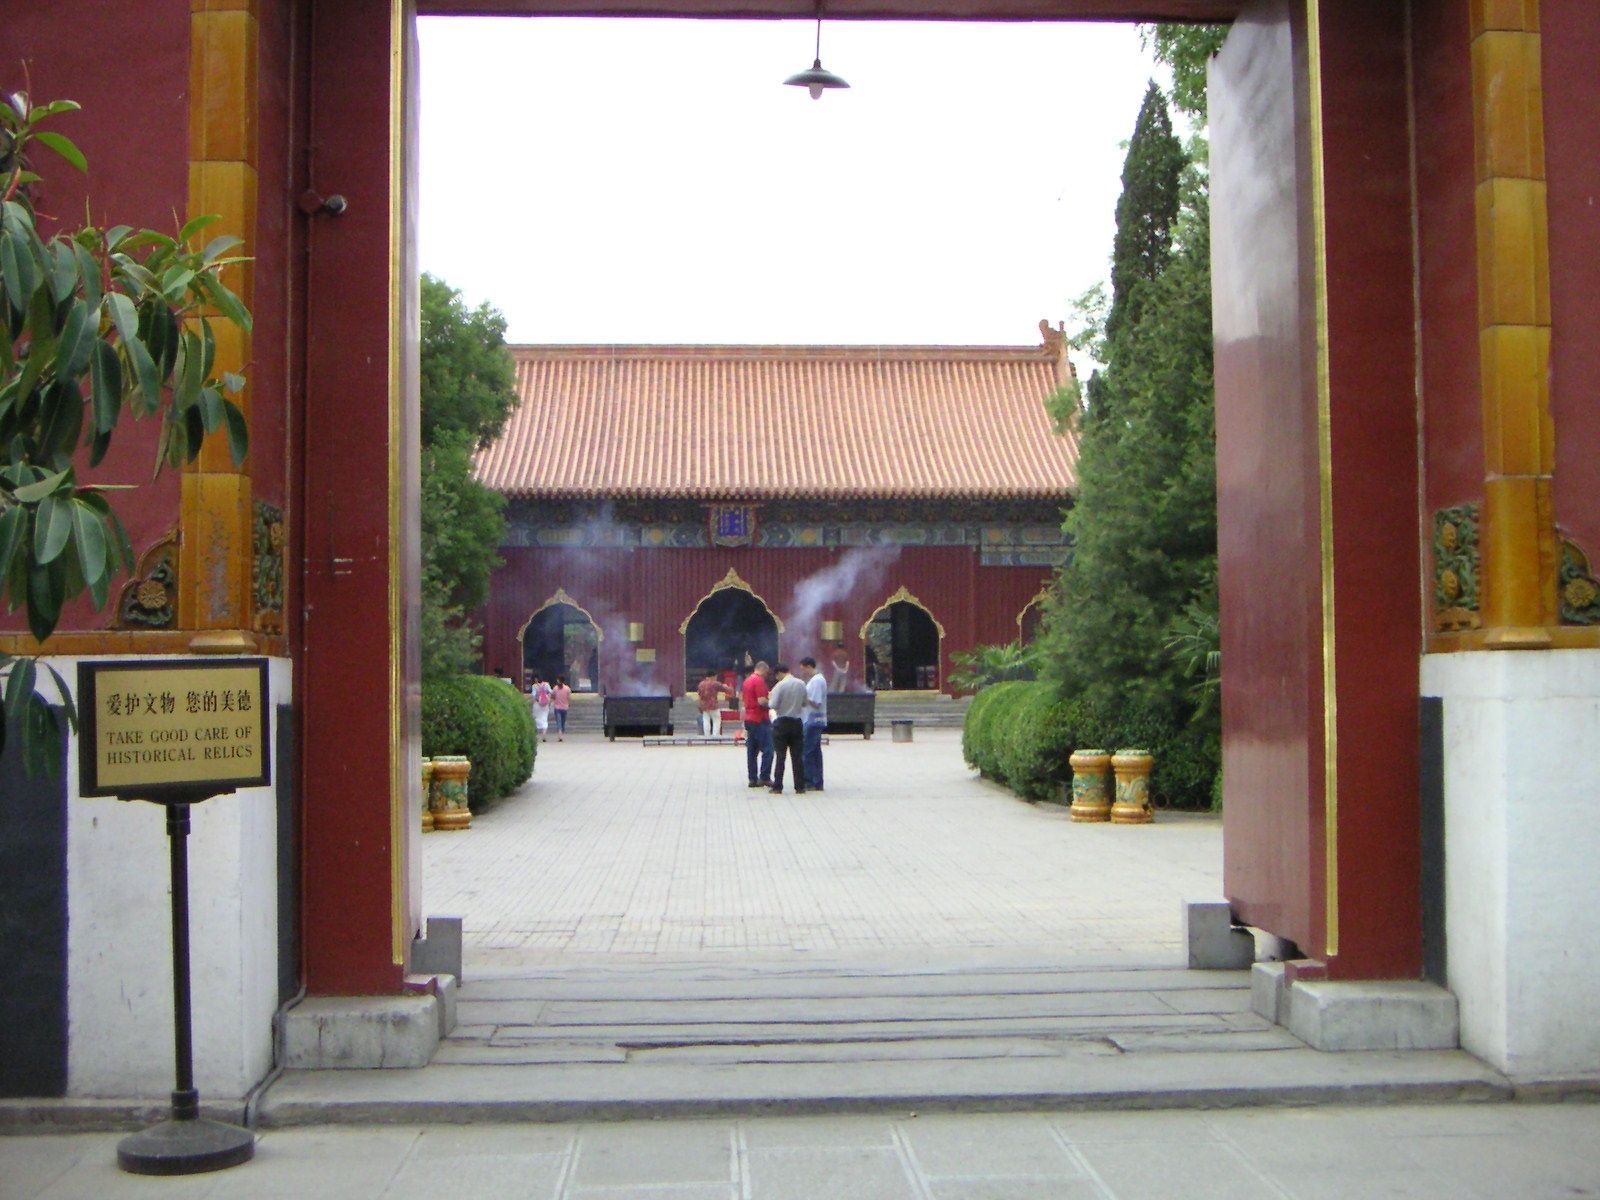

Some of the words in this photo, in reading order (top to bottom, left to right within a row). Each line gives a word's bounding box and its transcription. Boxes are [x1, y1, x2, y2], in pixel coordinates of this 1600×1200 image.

[106, 692, 175, 716] 爱护文物
[185, 689, 252, 713] 您的美德
[106, 731, 144, 746] TAKE
[150, 729, 188, 744] GOOD
[195, 727, 229, 741] CARE
[235, 726, 252, 739] OF
[107, 748, 195, 765] HISTORICAL
[204, 745, 253, 760] RELICS
